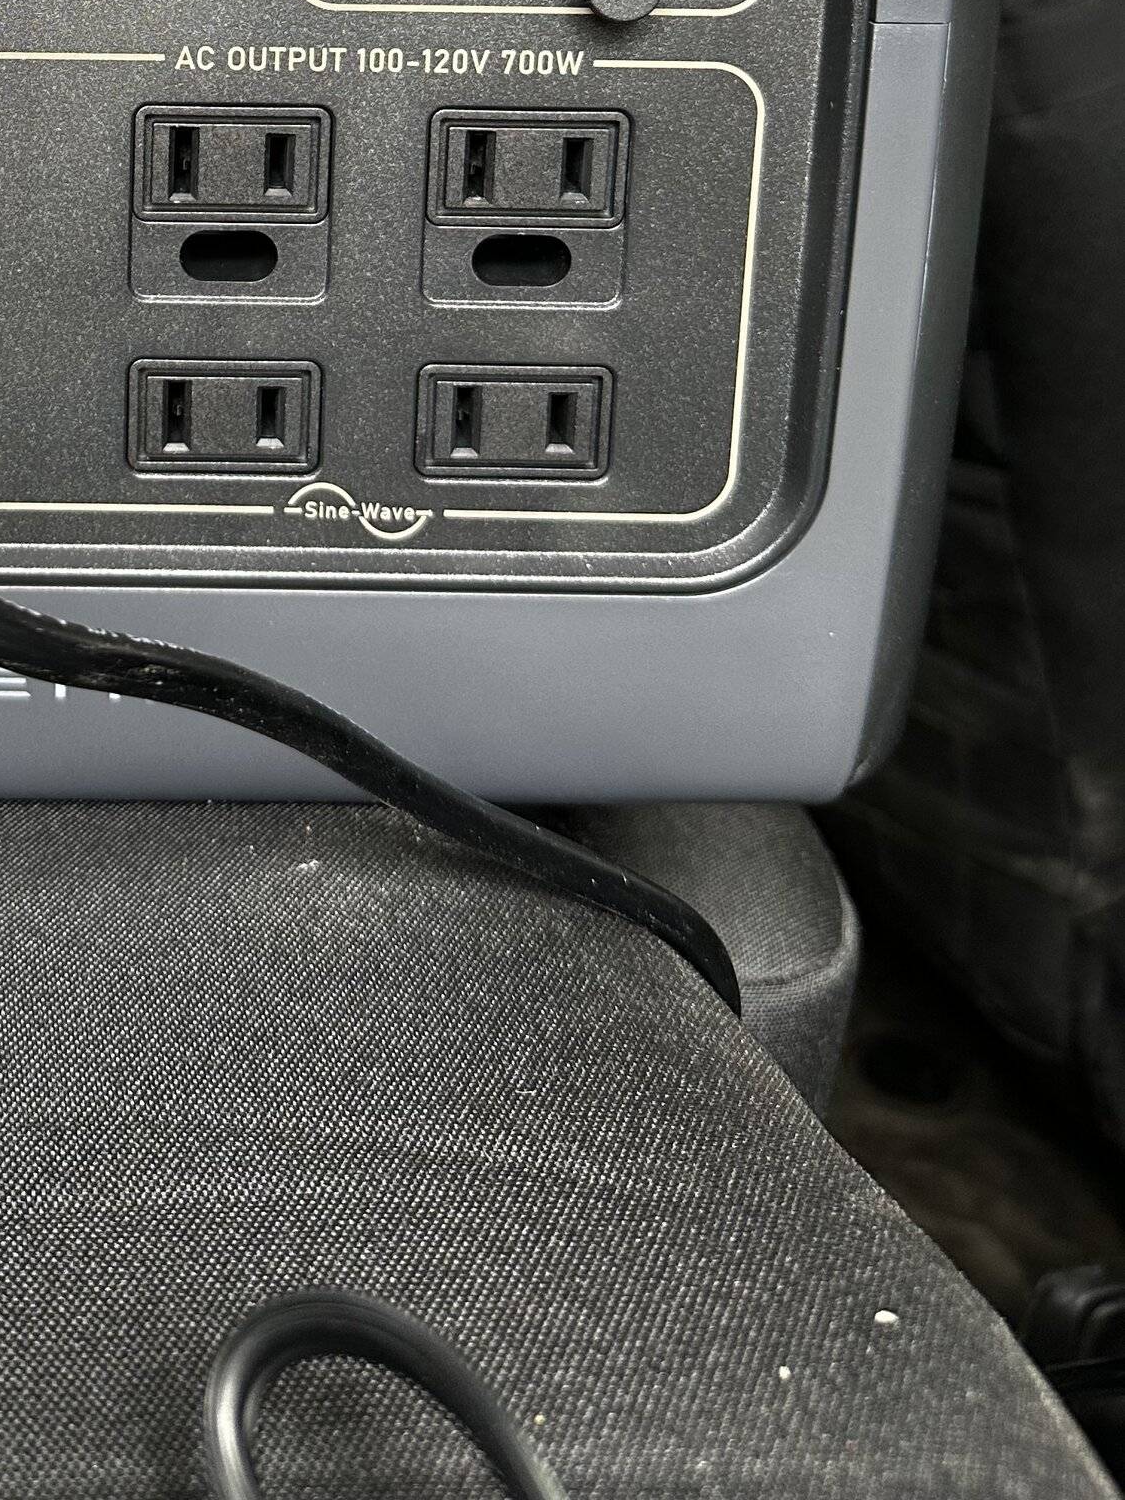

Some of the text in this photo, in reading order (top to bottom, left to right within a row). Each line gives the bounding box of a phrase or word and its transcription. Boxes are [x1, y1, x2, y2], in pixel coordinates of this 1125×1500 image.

[174, 46, 584, 76] AC OUTPUT 100-120V 700W
[303, 500, 416, 522] Sine-Wave
